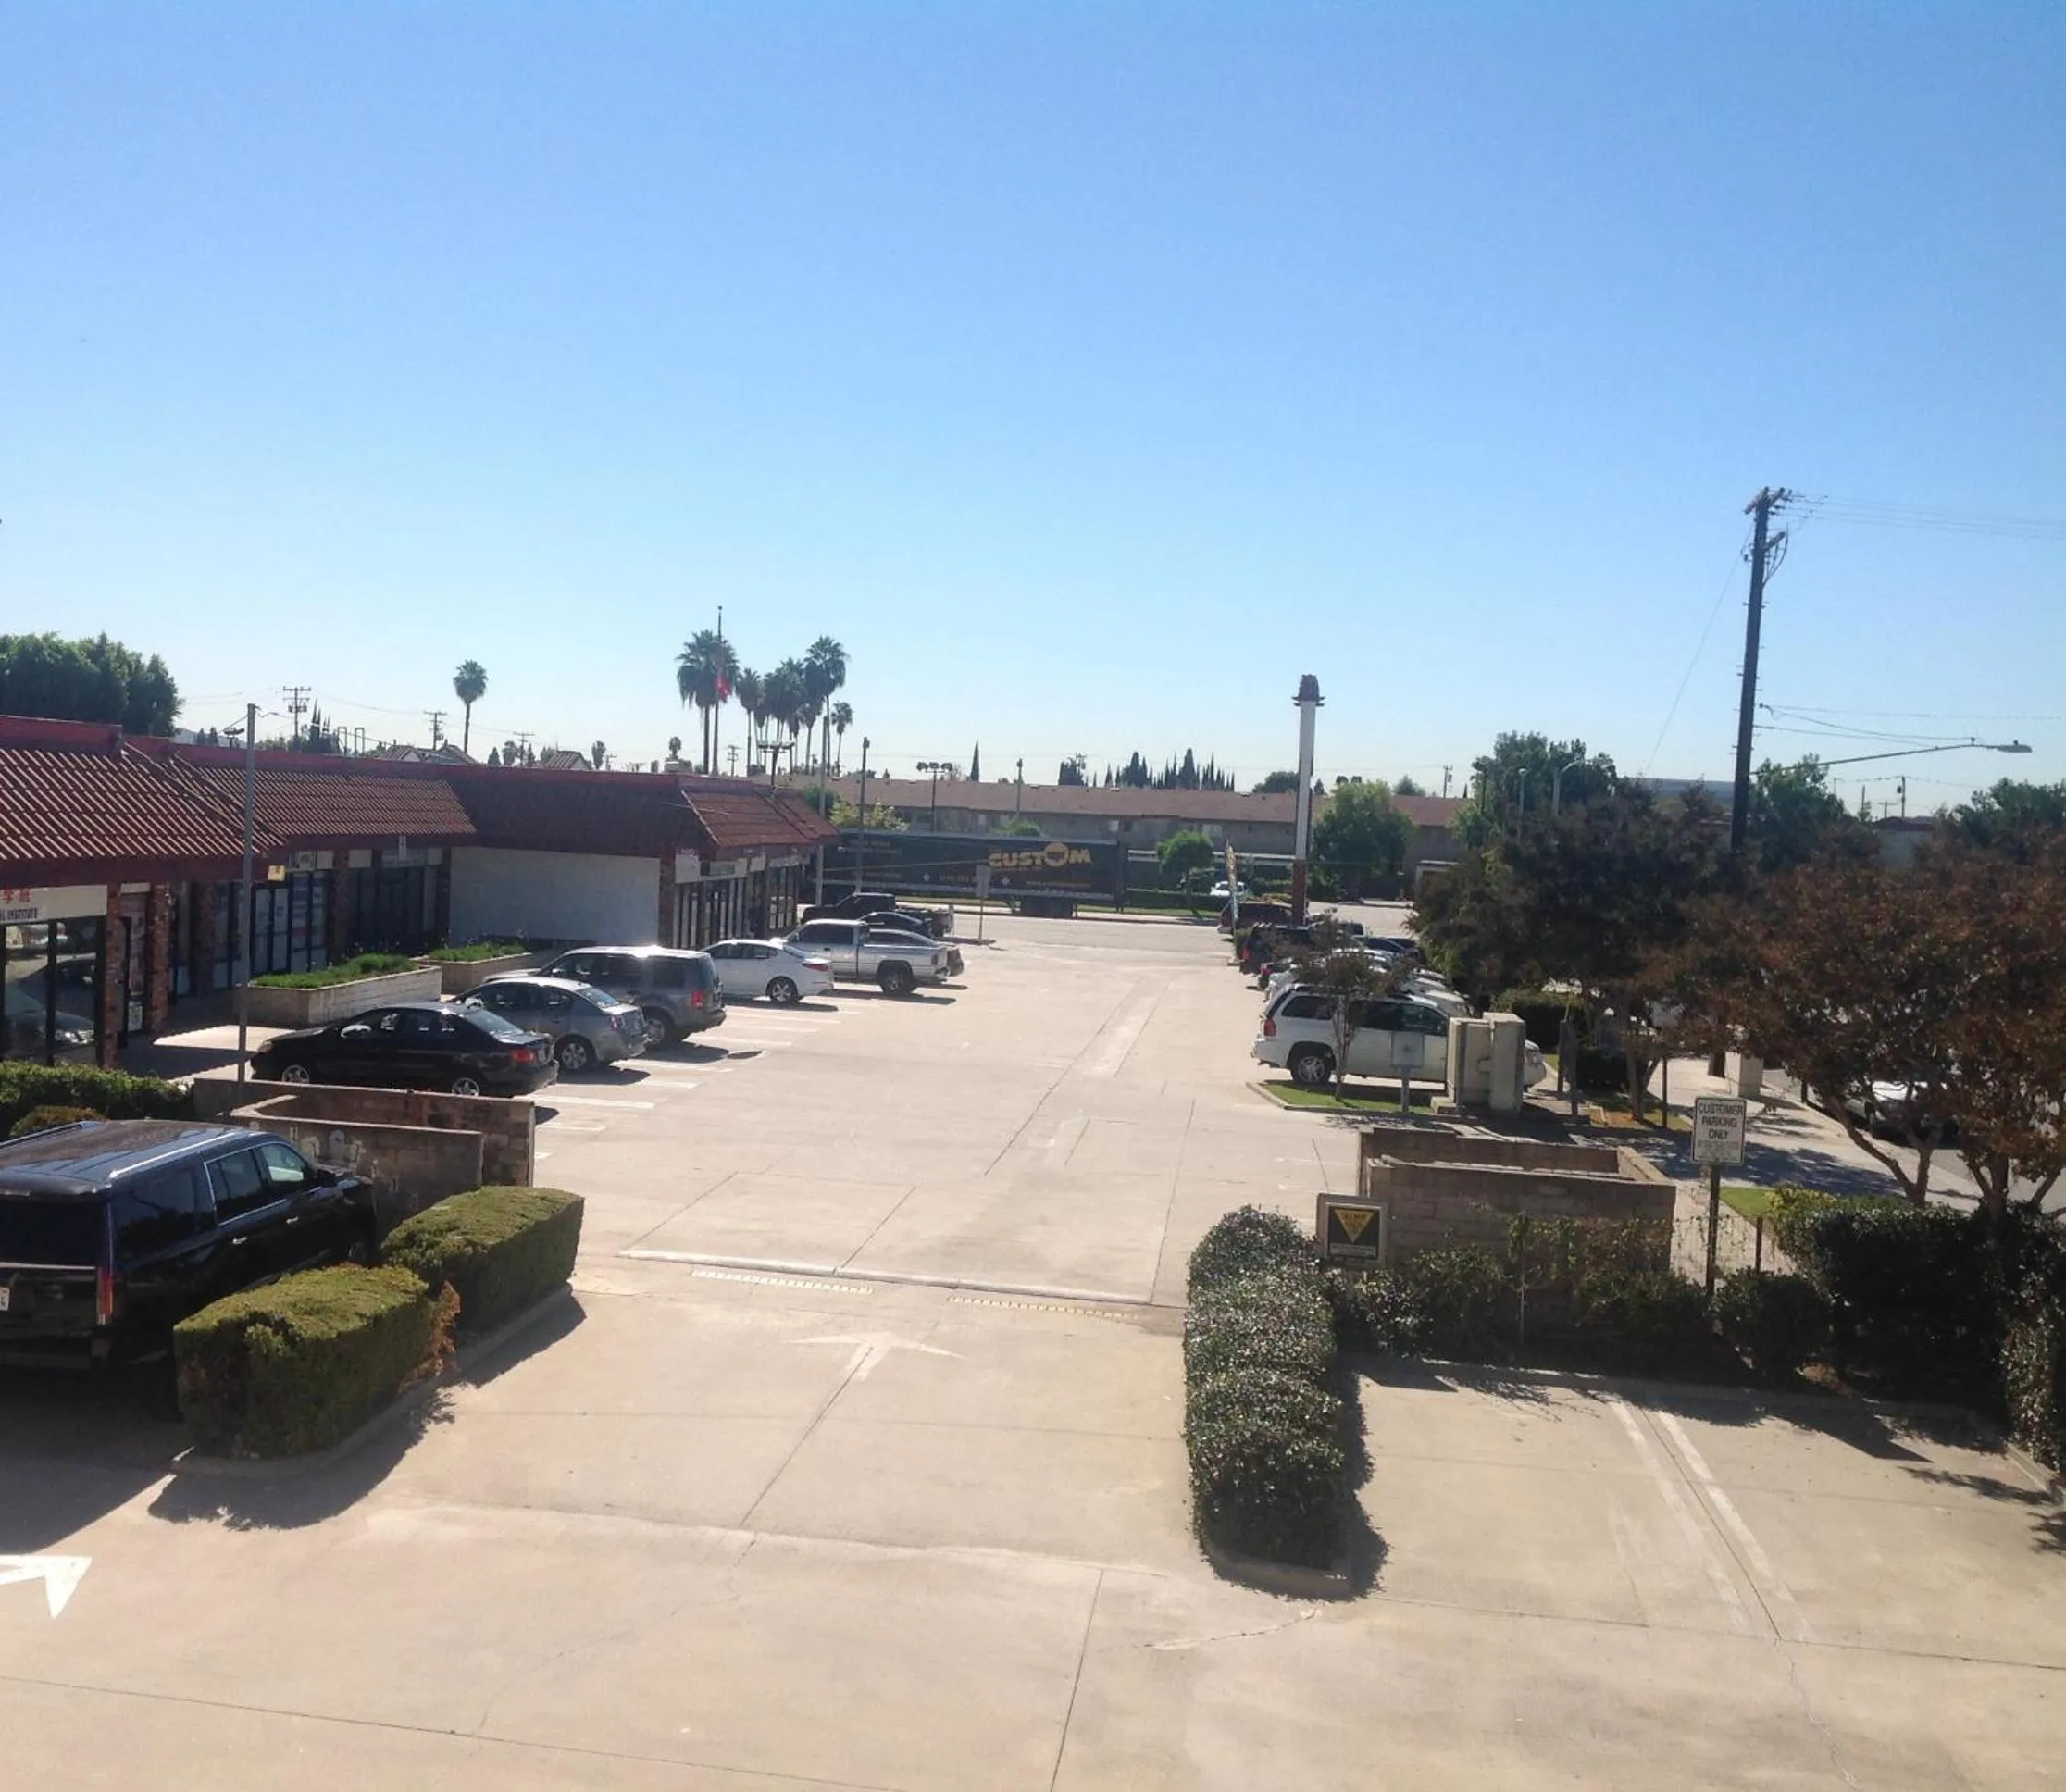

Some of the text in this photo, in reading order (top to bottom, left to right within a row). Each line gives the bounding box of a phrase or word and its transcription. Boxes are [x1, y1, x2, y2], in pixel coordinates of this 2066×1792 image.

[989, 841, 1092, 867] CUSTOM
[1699, 1102, 1743, 1115] CUSTOMER
[1701, 1116, 1737, 1127] PARKING
[1709, 1128, 1729, 1139] ONLY
